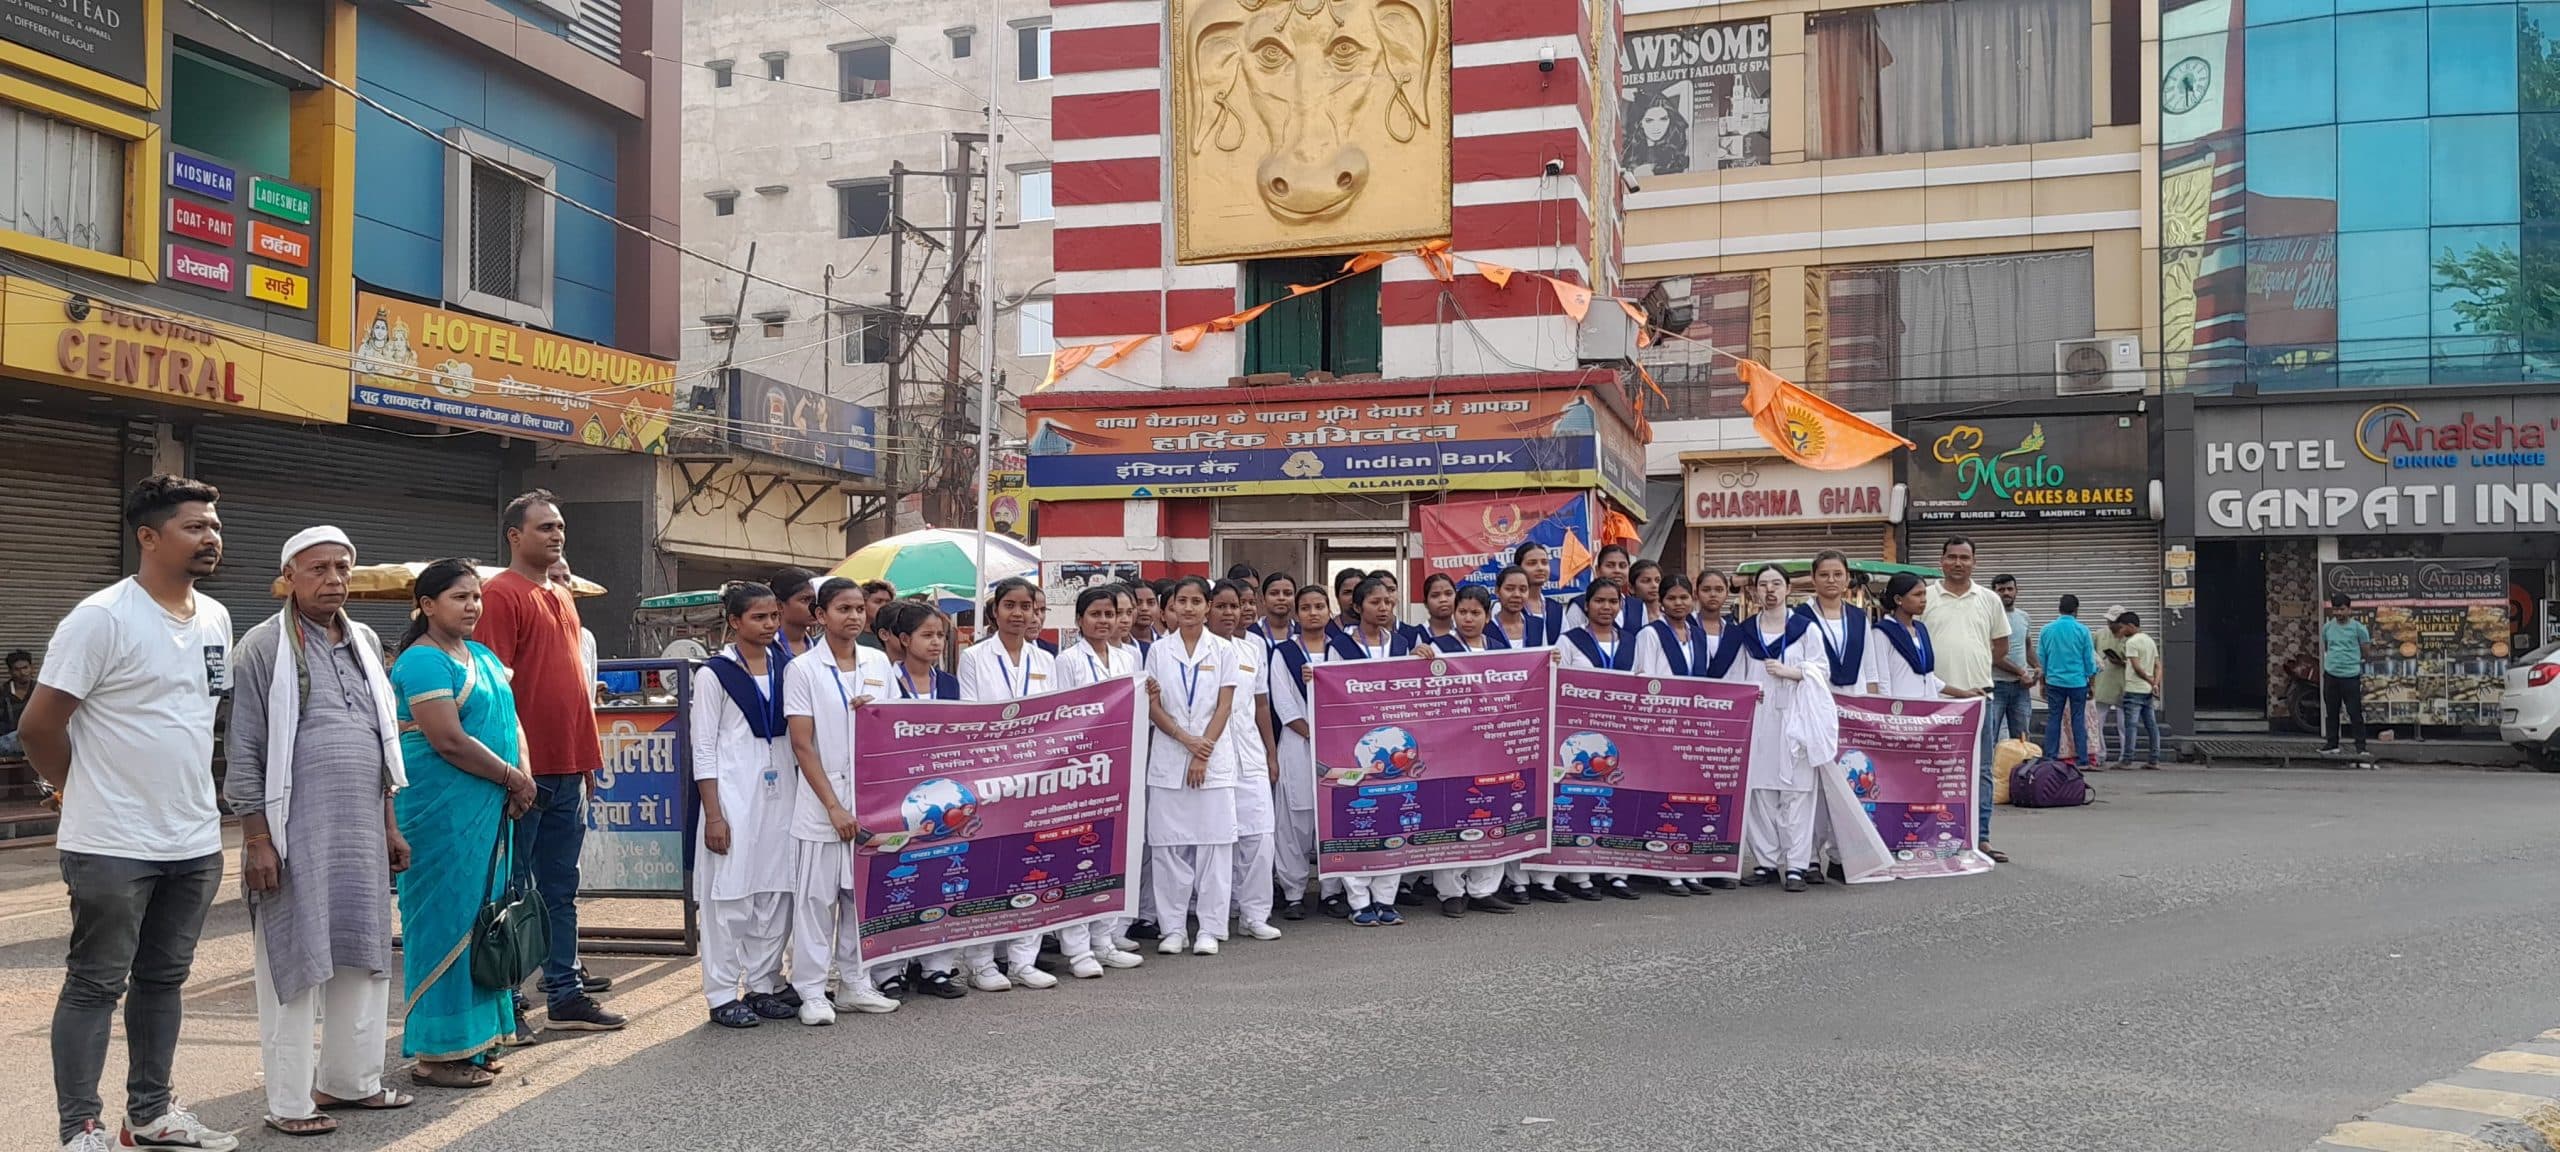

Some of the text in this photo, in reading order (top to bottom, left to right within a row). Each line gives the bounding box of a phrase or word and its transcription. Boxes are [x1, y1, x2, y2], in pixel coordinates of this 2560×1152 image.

[5, 13, 96, 54] A DIFFERENT LEAGUE
[1620, 23, 1770, 73] AWESOME
[1646, 68, 1688, 83] BEAUTY
[1738, 61, 1748, 74] &
[1750, 60, 1770, 73] SPA
[176, 162, 233, 193] KIDSWEAR
[256, 186, 309, 216] LADIESWEAR
[208, 217, 233, 238] PANT
[260, 234, 302, 258] लहंगा
[176, 254, 230, 283] शेरवानी
[264, 276, 295, 301] साड़ी
[58, 327, 245, 403] CENTRAL
[421, 312, 675, 397] HOTEL MADHUBAN
[382, 392, 431, 412] शाकाहरी
[464, 403, 479, 419] एवं
[479, 407, 509, 426] भोजन
[510, 411, 522, 426] के
[522, 413, 541, 428] लिए
[1095, 417, 1139, 430] बाबा
[1226, 409, 1249, 426] के
[1254, 409, 1308, 424] पावन
[1316, 403, 1360, 425] भूमि
[1366, 402, 1425, 420] देवघर
[1429, 398, 1454, 417] में
[1460, 399, 1531, 416] आपका
[1151, 422, 1459, 453] हार्दिक अभिनंदन
[1115, 457, 1240, 481] इंडियन बैंक
[1345, 449, 1514, 471] Indian Bank
[2206, 439, 2346, 476] HOTEL
[2393, 452, 2546, 470] DINING LOUNGE
[1158, 483, 1240, 496] इलाहाबाद
[1347, 476, 1450, 490] ALLAHABAD
[1957, 454, 2065, 502] Mailo
[1696, 485, 1882, 519] CHASHMA GHAR
[2013, 486, 2134, 506] CAKES & BAKES
[2206, 482, 2560, 532] GANPATI INN
[1921, 508, 2133, 520] PASTRY BURGER PIZZA SANDWICH PETTIES
[1431, 552, 1489, 570] यातायात
[2415, 614, 2460, 624] LUNCH
[2416, 623, 2460, 632] BUFFET
[1345, 668, 1529, 695] विश्व उच्च रक्तचाप दिवस
[1410, 690, 1422, 698] 17
[1446, 686, 1472, 695] 2025
[1561, 683, 1734, 711] विश्व उच्च रक्तचाप दिवस
[894, 701, 1105, 739] विश्व उच्च रक्तचाप दिवस
[1008, 727, 1036, 737] 2025
[595, 719, 677, 790] पुलिस
[974, 752, 1114, 806] प्रभातफेरी
[590, 796, 632, 826] सेवा
[638, 793, 660, 826] में
